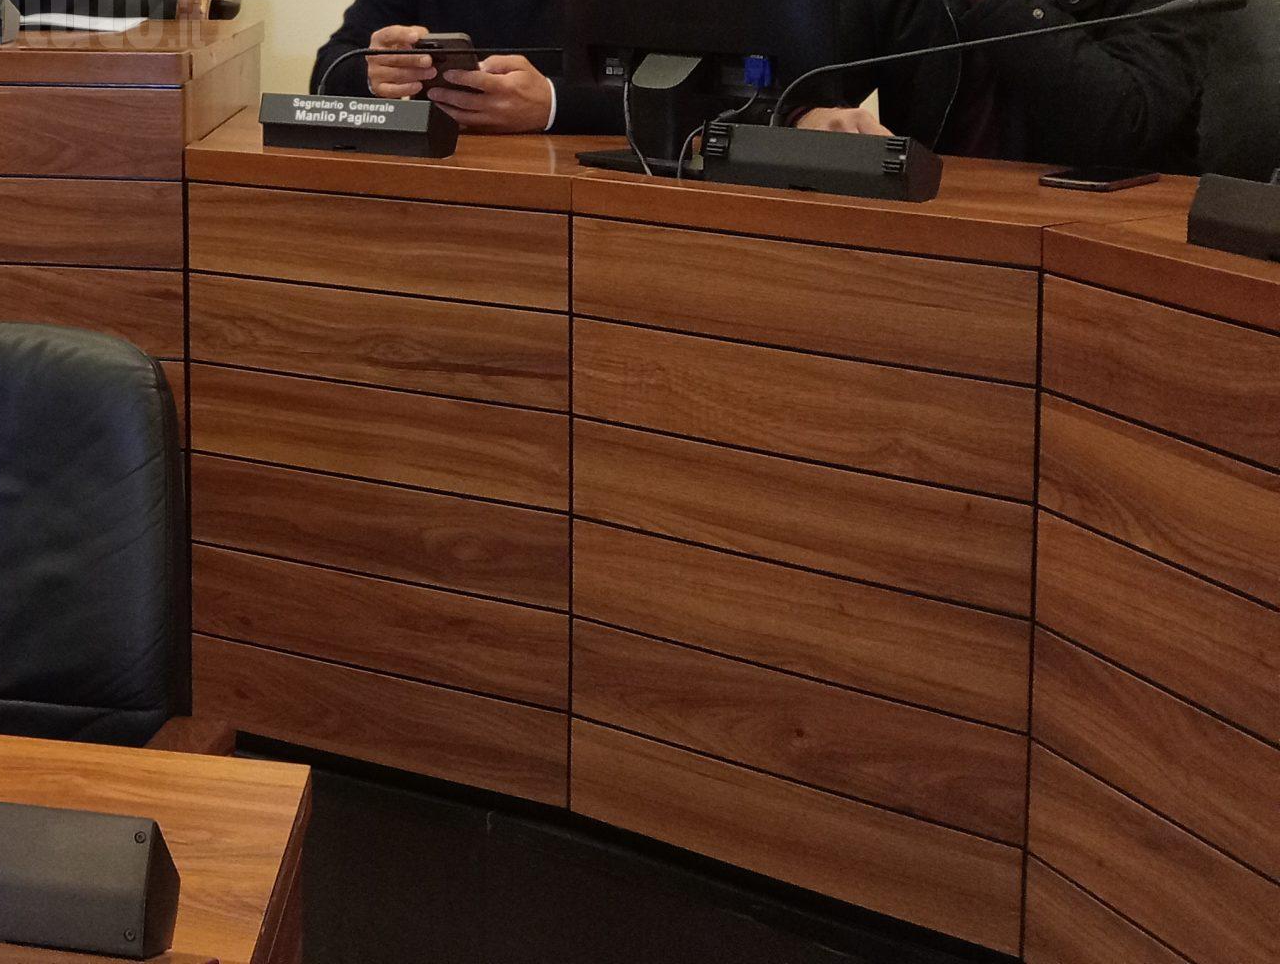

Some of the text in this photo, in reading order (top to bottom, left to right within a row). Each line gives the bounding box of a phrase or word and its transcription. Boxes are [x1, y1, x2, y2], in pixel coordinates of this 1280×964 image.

[293, 98, 395, 113] Segretario Generale
[295, 110, 386, 126] Manlio Paglino
